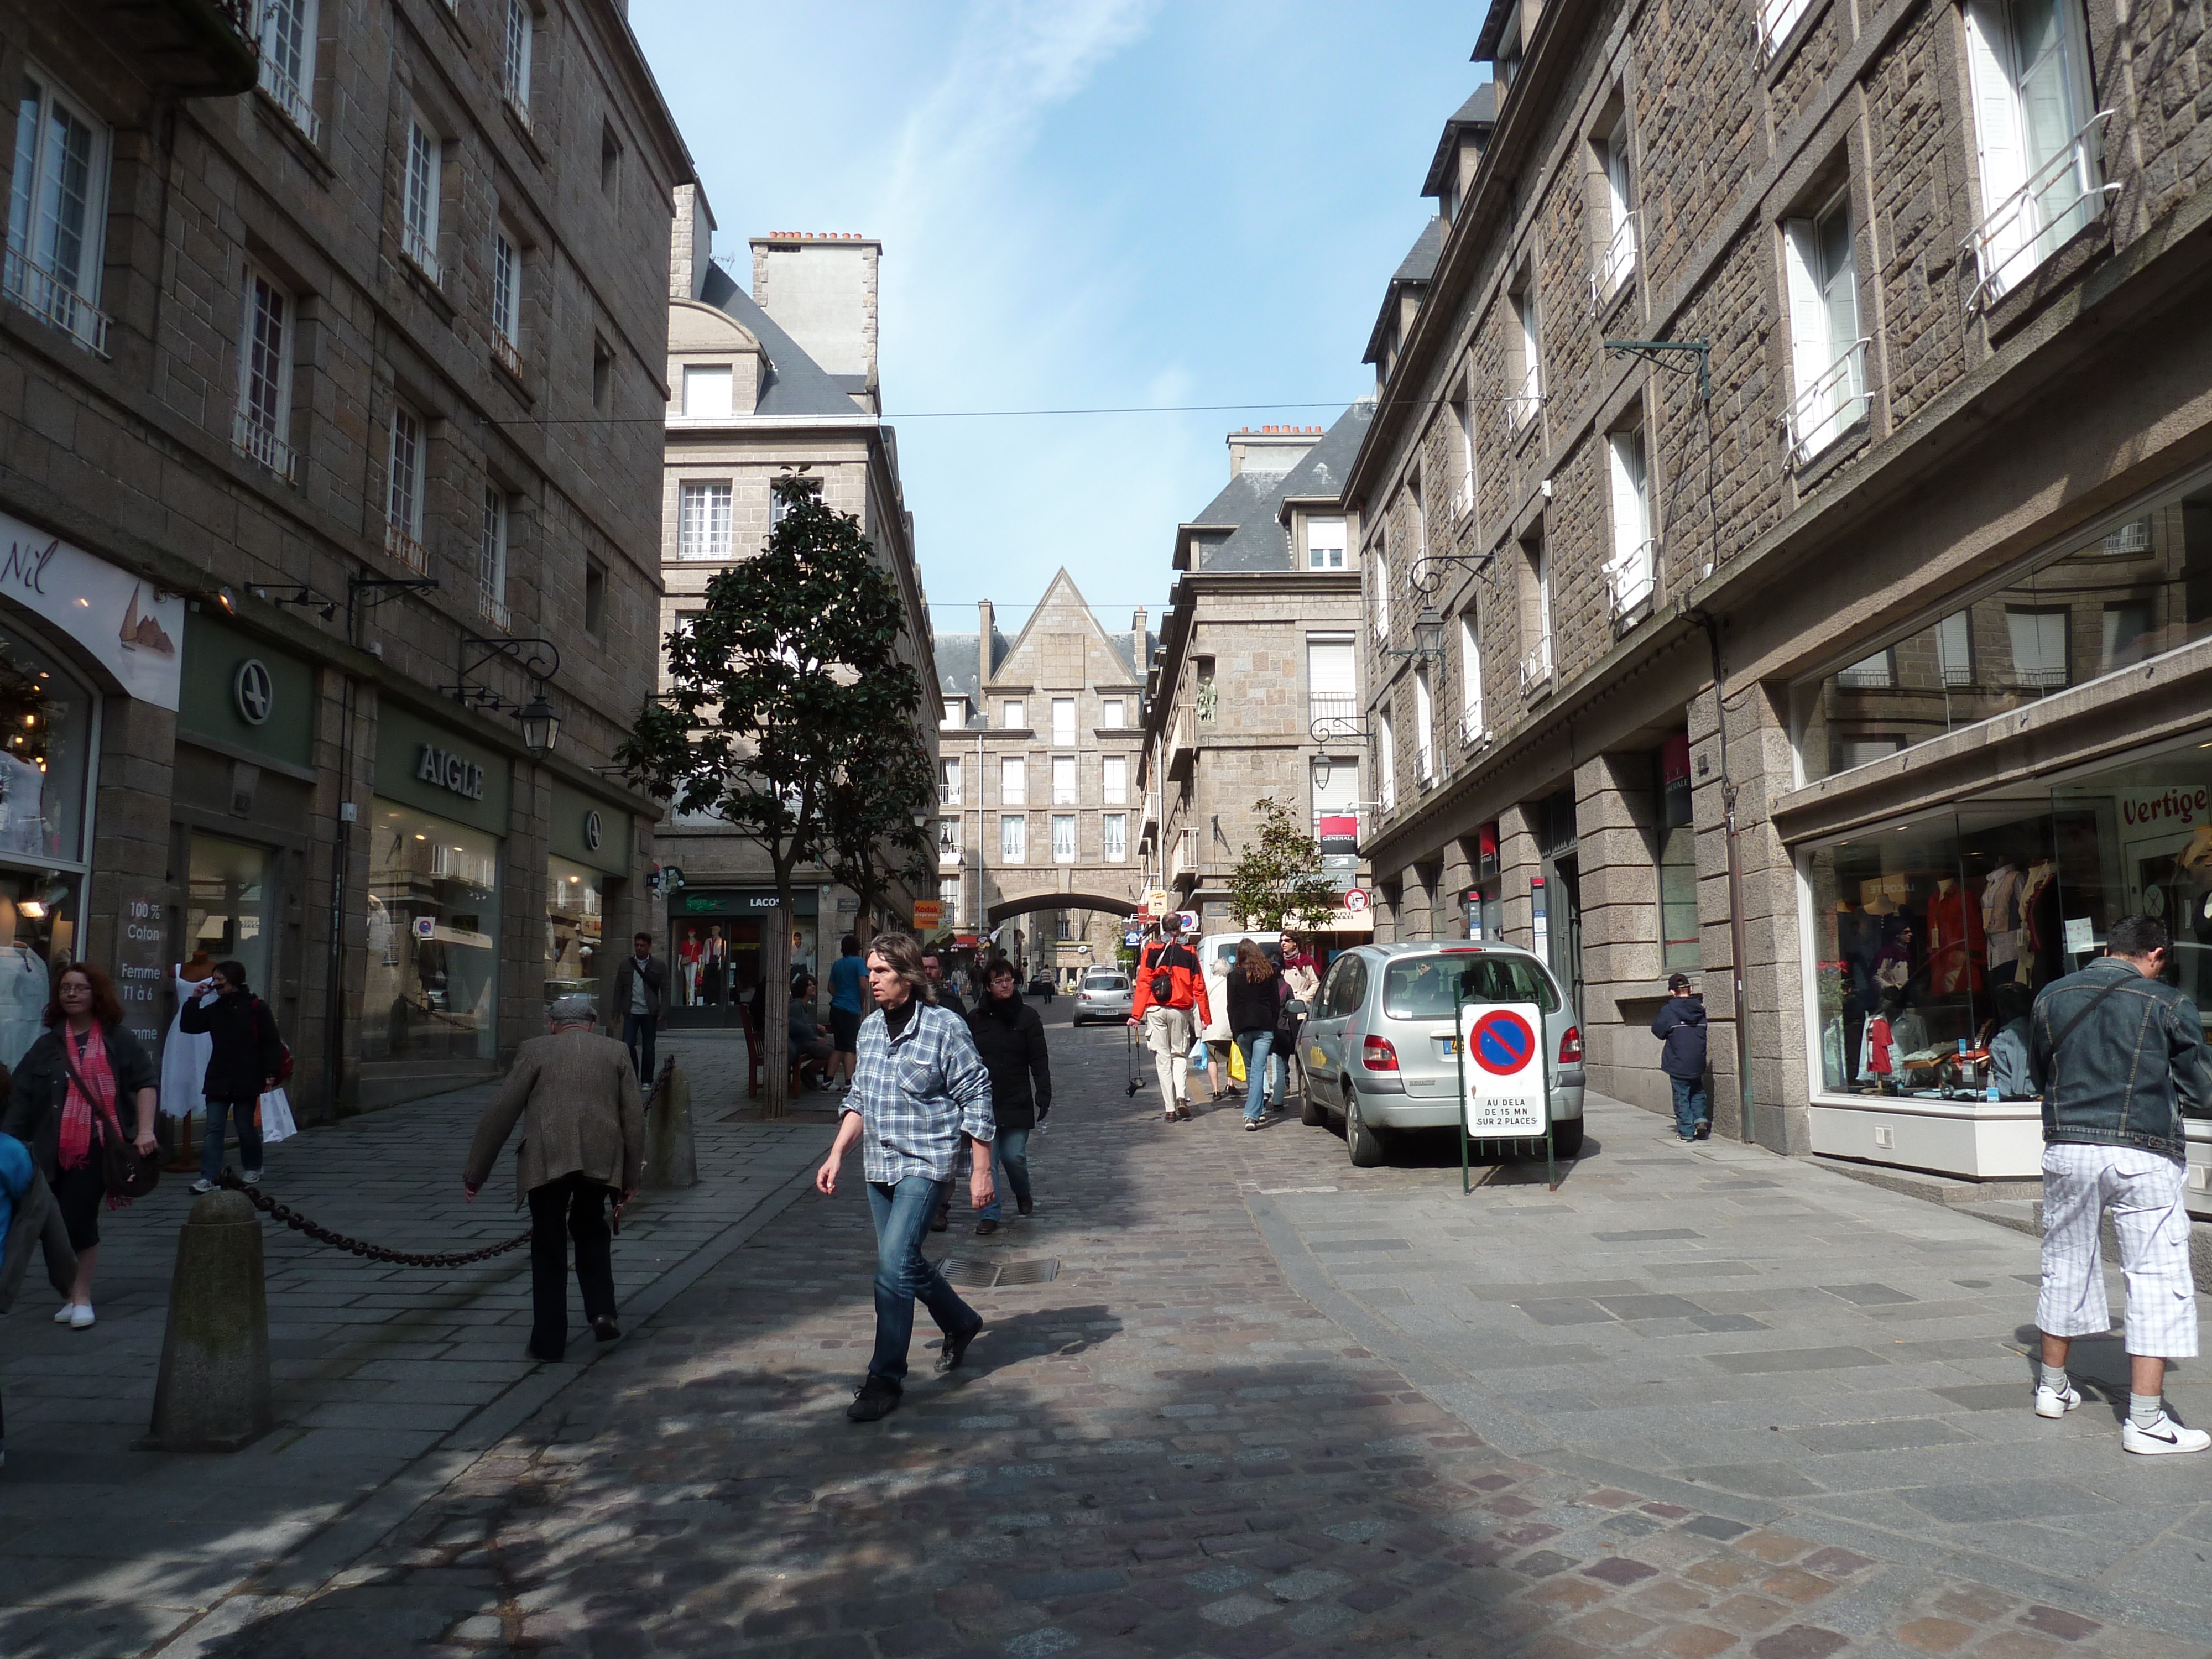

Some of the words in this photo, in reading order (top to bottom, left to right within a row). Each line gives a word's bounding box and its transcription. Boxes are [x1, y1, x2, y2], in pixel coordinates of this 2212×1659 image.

[0, 539, 59, 594] Nil
[417, 743, 484, 801] AIGLE
[2123, 788, 2208, 825] Vertige
[130, 902, 148, 918] 100
[128, 924, 159, 941] Coton
[121, 963, 161, 979] Femme
[147, 987, 153, 1001] 6
